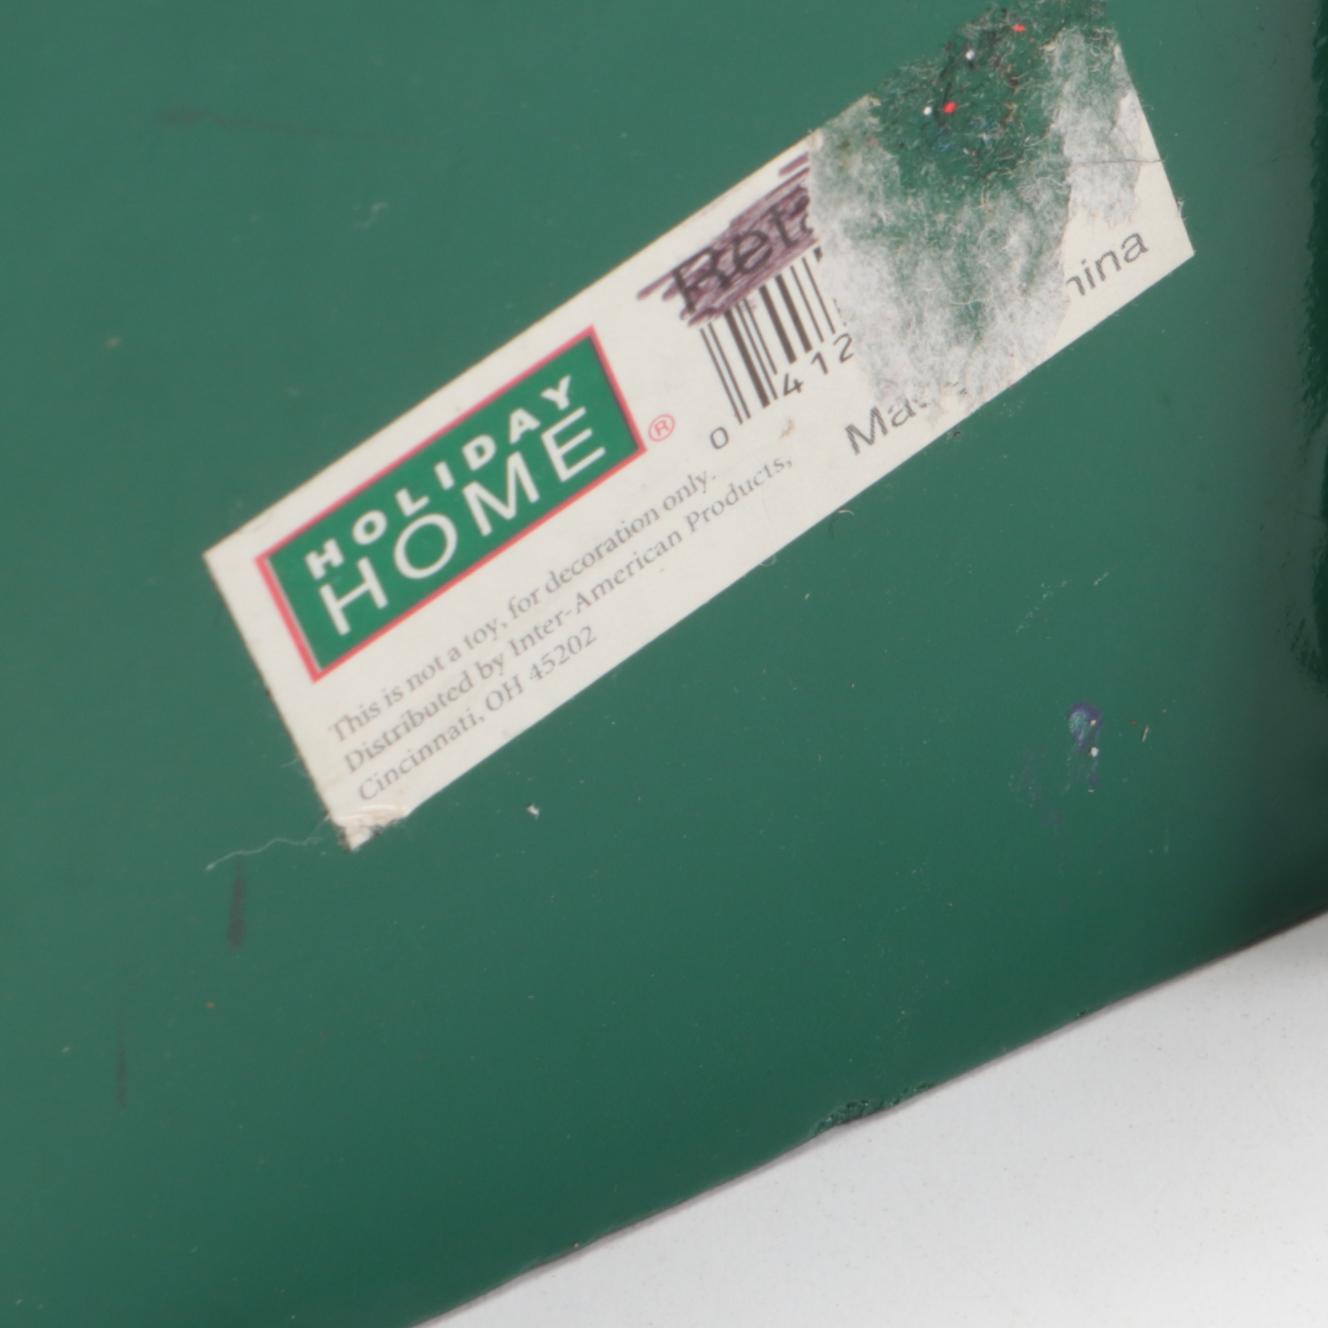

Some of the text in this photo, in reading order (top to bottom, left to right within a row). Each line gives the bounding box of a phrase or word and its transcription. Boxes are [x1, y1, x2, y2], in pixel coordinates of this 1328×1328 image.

[305, 375, 572, 579] HOLIDAY
[319, 406, 606, 636] HOME
[329, 470, 718, 743] This is not a toy, for decoration only.
[344, 456, 793, 773] Distributed by Inter-American Products,
[359, 625, 598, 801] Cincinnati, OH 45202
